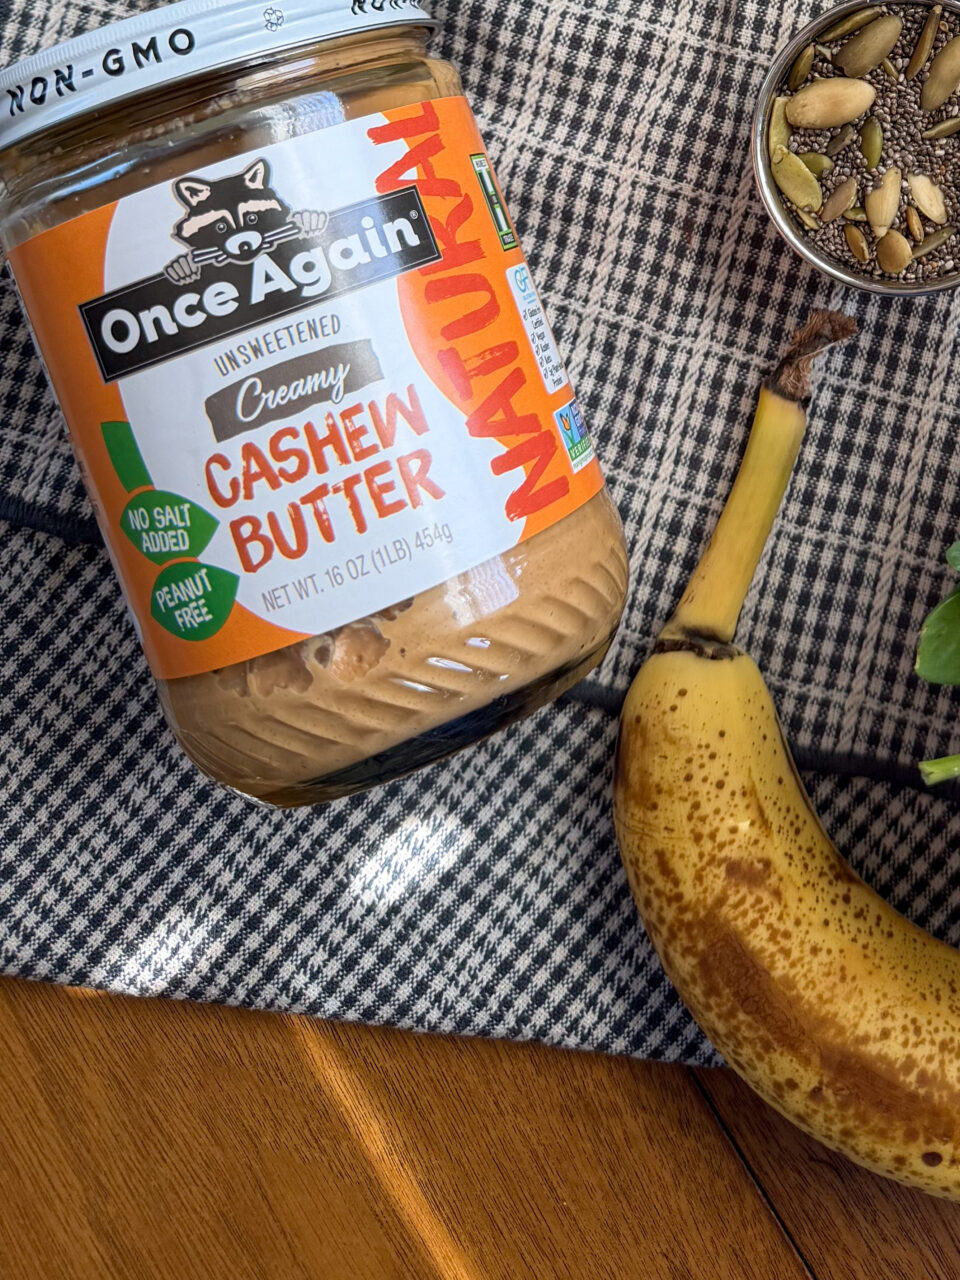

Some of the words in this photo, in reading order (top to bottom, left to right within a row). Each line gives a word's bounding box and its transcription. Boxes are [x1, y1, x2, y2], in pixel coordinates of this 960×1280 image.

[6, 28, 196, 116] NON-GMO
[101, 280, 239, 353] Once
[367, 100, 570, 522] NATURAL
[213, 314, 342, 376] UNSWEETENED
[235, 361, 351, 422] Creamy
[205, 384, 431, 509] CASHEW
[128, 507, 150, 531] NO
[153, 503, 191, 528] SALT
[142, 530, 190, 553] ADDED
[230, 448, 446, 573] BUTTER
[155, 568, 213, 613] PEANUT
[261, 584, 292, 613] NET
[292, 573, 325, 601] WT.
[325, 565, 344, 588] 16
[345, 554, 370, 580] OZ
[371, 537, 412, 574] (1LB)
[415, 522, 454, 550] 454g
[174, 598, 213, 631] FREE
